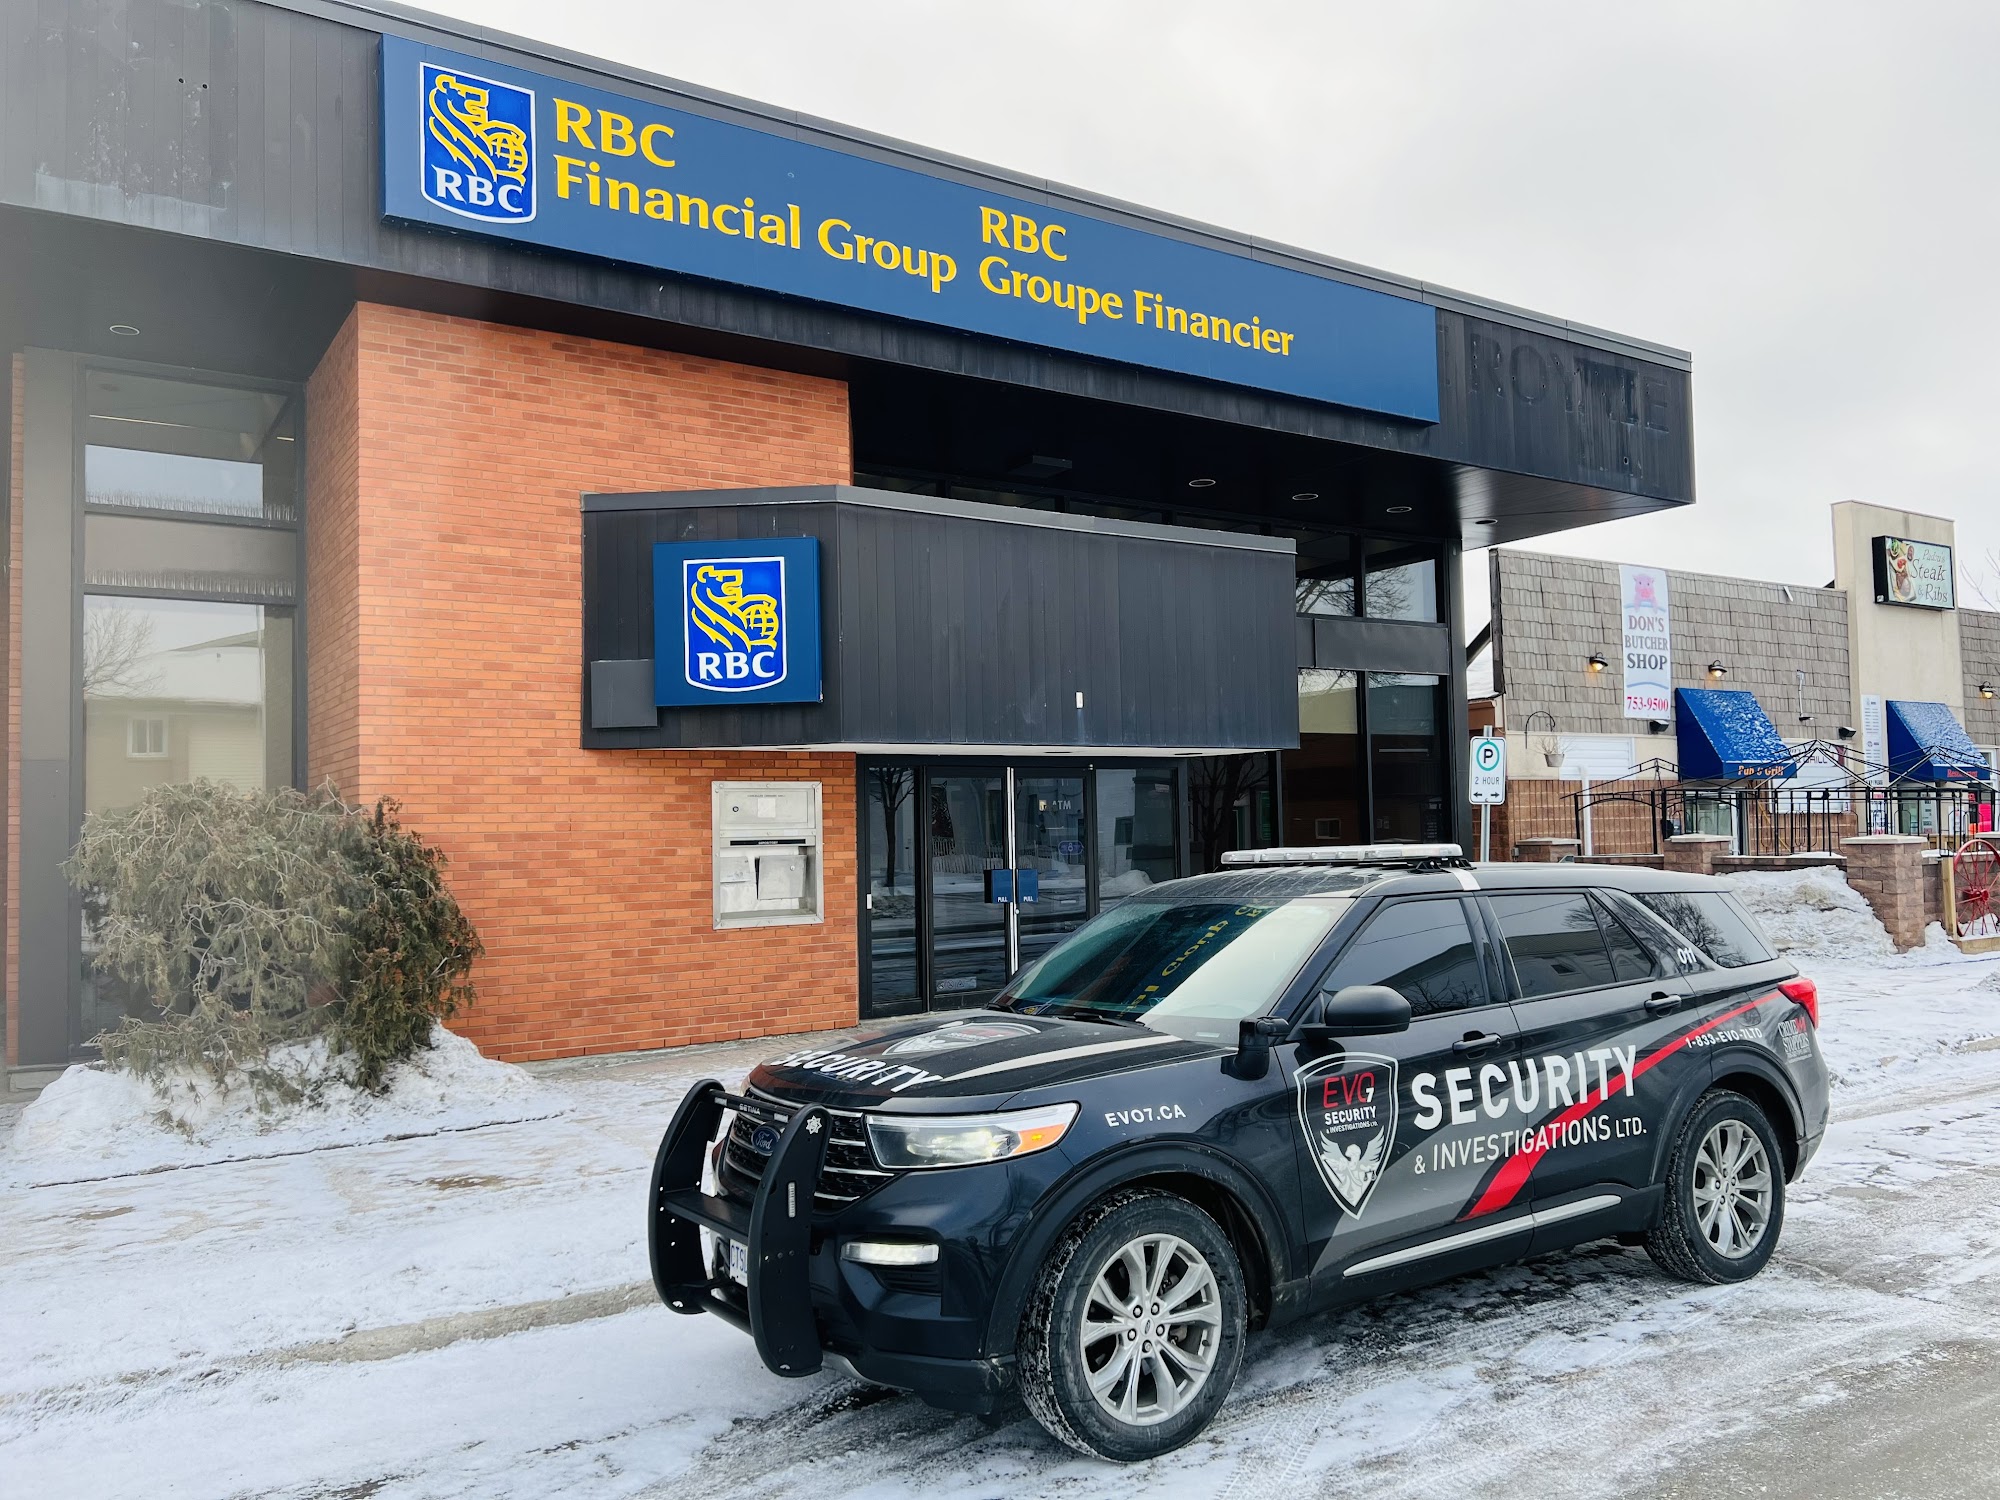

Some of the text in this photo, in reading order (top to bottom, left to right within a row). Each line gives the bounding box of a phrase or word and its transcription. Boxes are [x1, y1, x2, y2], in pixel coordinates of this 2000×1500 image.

[552, 97, 676, 168] RBC
[432, 163, 525, 214] RBC
[553, 153, 958, 294] Financial Group
[979, 206, 1068, 262] RBC
[979, 255, 1294, 356] Groupe Financier
[1910, 558, 1947, 582] Steak
[1917, 583, 1948, 602] & Ribs
[1628, 615, 1665, 633] DON'S
[1624, 634, 1669, 651] BUTCHER
[696, 651, 776, 681] RBC
[1627, 652, 1668, 671] SHOP
[1626, 696, 1669, 712] 753-9500
[1483, 748, 1494, 764] P
[1474, 776, 1500, 785] 2 HOUR
[1738, 765, 1755, 776] Pub
[1764, 765, 1784, 776] Grill
[1677, 947, 1698, 965] 011
[1685, 1028, 1763, 1049] 1-833-EVO-7LTD
[770, 1050, 944, 1093] SECURITY
[1411, 1044, 1636, 1131] SECURITY
[1104, 1104, 1187, 1127] EVO7.CA
[1324, 1105, 1377, 1126] SECURITY
[1329, 1120, 1371, 1134] INVESTIGATIONS
[755, 1130, 774, 1150] Ford
[1414, 1114, 1648, 1175] & INVESTIGATIONS LTD.
